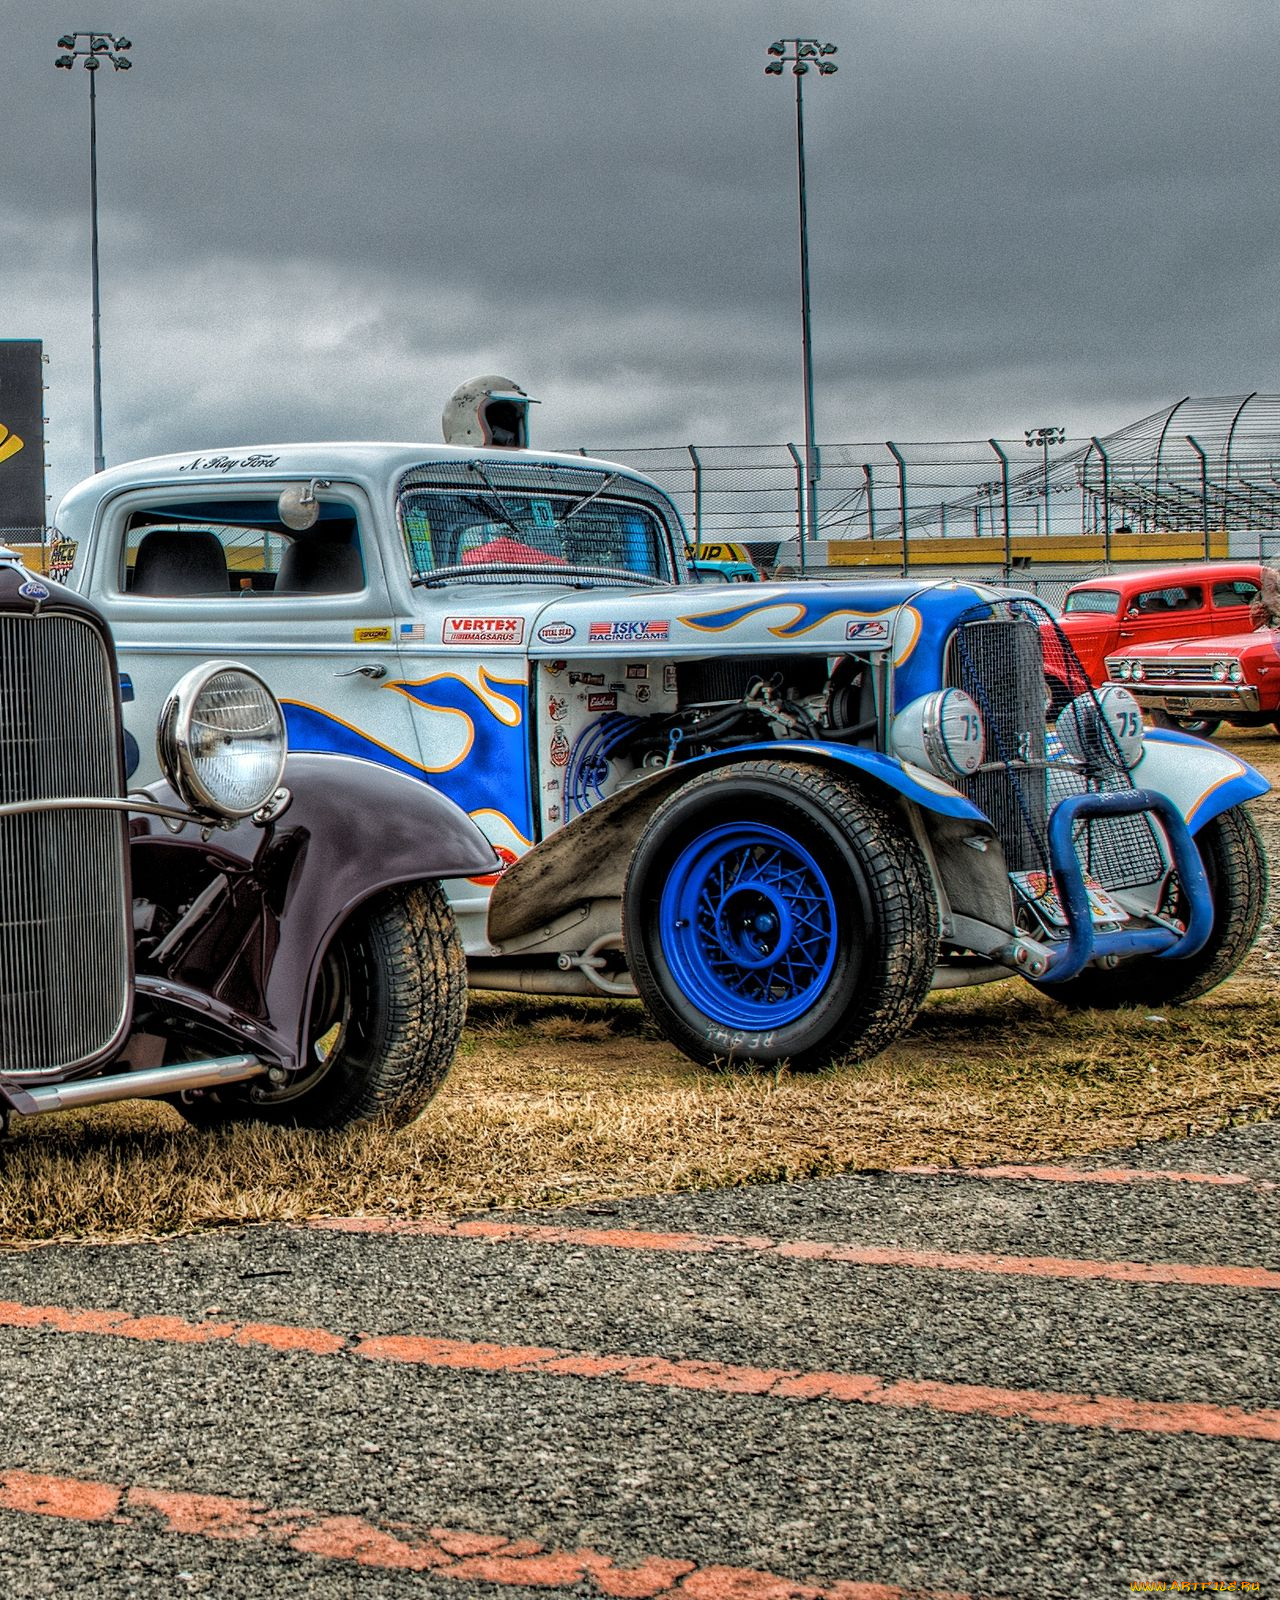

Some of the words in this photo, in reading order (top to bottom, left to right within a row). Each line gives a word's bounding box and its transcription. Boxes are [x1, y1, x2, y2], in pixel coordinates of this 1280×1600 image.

[203, 456, 239, 473] Ray
[240, 454, 281, 468] Ford
[451, 619, 517, 631] VERTEX
[612, 622, 648, 634] ISKY
[634, 632, 668, 640] CAMS
[960, 715, 979, 741] 75
[1116, 711, 1137, 738] 75
